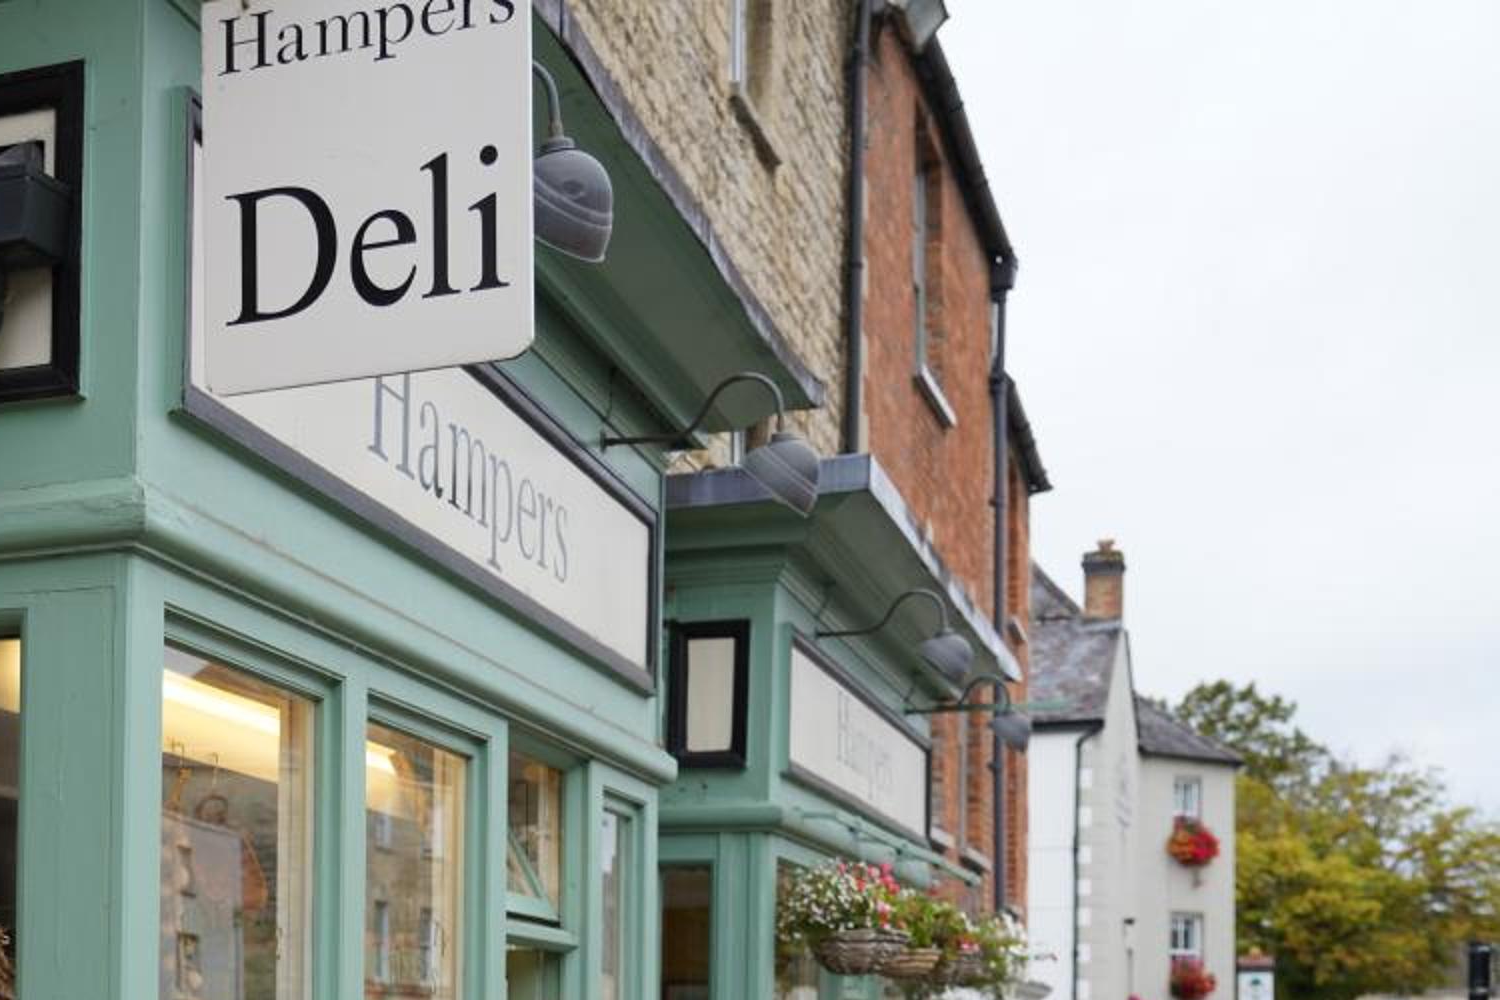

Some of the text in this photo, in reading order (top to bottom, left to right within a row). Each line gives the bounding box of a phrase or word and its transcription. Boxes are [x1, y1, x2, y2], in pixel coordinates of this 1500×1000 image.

[217, 0, 515, 76] Hampers
[224, 144, 510, 327] Deli
[367, 371, 569, 583] Hampers
